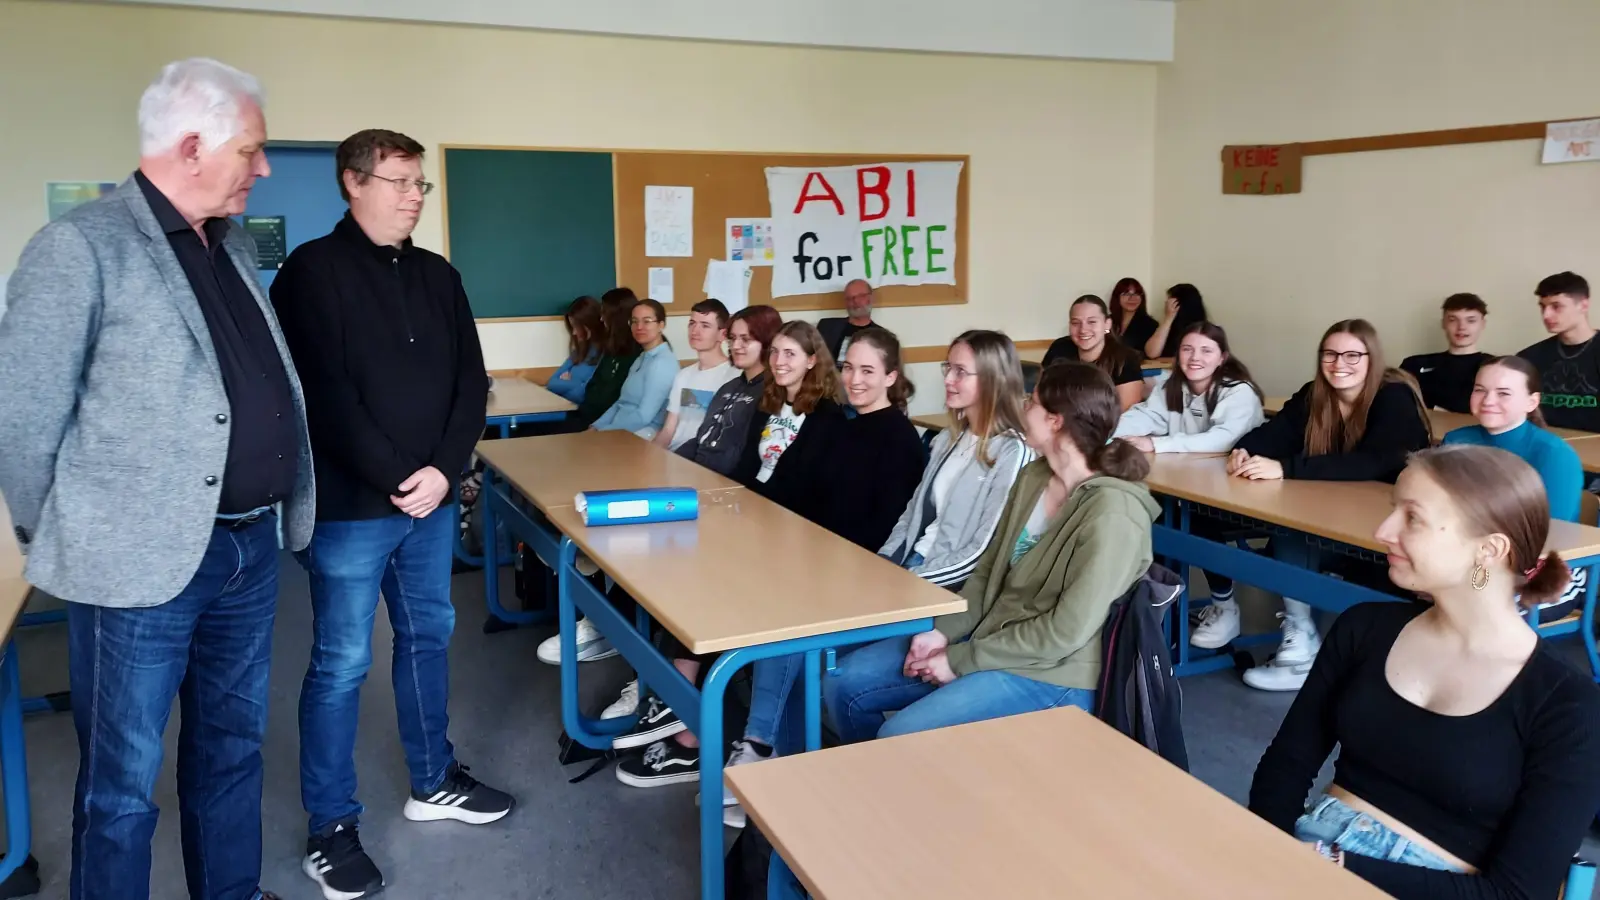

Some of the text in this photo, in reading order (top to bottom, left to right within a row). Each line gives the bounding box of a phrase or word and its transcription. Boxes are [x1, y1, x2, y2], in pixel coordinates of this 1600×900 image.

[793, 166, 916, 222] ABI
[792, 231, 853, 283] for
[861, 224, 948, 279] FREE
[1541, 393, 1598, 409] appa
